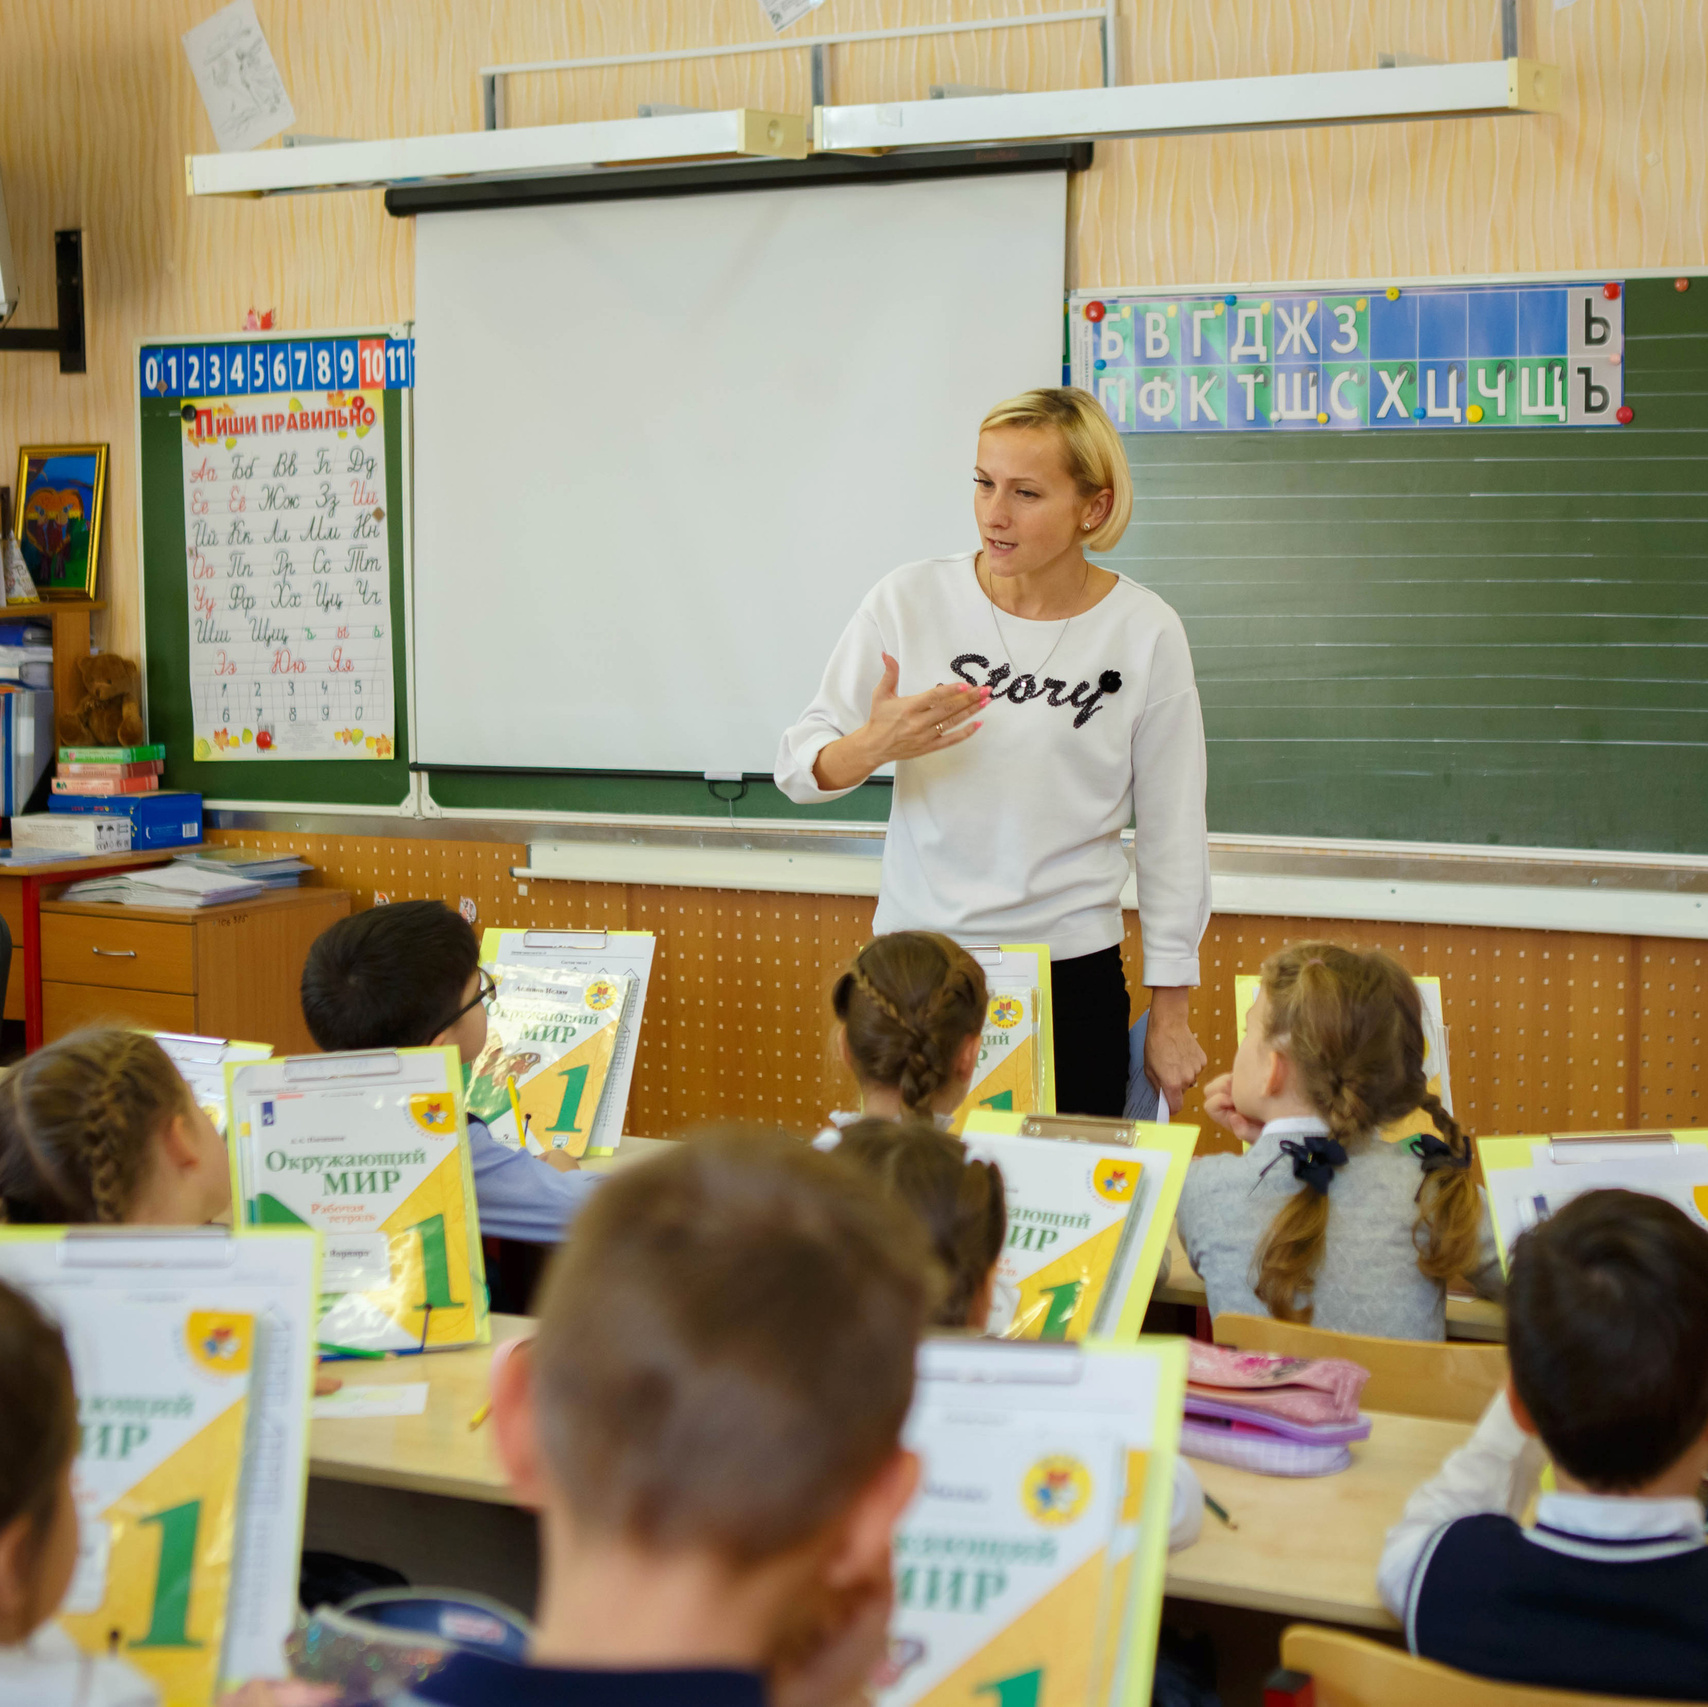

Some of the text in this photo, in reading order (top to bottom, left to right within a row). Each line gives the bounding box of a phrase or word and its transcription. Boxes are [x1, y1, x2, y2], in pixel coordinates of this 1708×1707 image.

[1101, 313, 1124, 360] Б
[1145, 312, 1170, 359] В
[1193, 310, 1217, 357] Г
[1230, 308, 1268, 363] Д
[1276, 306, 1318, 355] Ж
[1330, 305, 1359, 354] З
[1585, 298, 1611, 347] Ь
[145, 356, 158, 390] 0
[167, 355, 177, 389] 1
[188, 355, 200, 389] 2
[209, 354, 221, 388] 3
[230, 353, 245, 387] 4
[254, 352, 265, 387] 5
[273, 351, 287, 386] 6
[294, 351, 307, 385] 7
[317, 349, 332, 384] 8
[340, 349, 354, 383] 9
[362, 348, 384, 383] 10
[387, 347, 406, 381] 11
[1138, 376, 1176, 422] Ф
[1190, 375, 1219, 421] К
[1237, 373, 1265, 421] Т
[1277, 372, 1317, 420] Ш
[1330, 371, 1358, 420] С
[1376, 370, 1409, 419] Х
[1427, 369, 1462, 423] Ц
[1477, 368, 1506, 417] Ч
[1521, 366, 1566, 422] Щ
[1577, 366, 1611, 414] Ъ
[189, 457, 218, 483] Аа
[231, 453, 260, 480] Бб
[273, 452, 298, 477] Вв
[347, 447, 377, 480] Дд
[191, 488, 209, 515] Ее
[258, 486, 300, 511] Жж
[315, 484, 340, 518] Зз
[350, 480, 378, 507] Ии
[192, 512, 381, 547] Йй Кк Лл Мм Нн
[192, 545, 382, 584] Оо Пп Рр Сс Тт
[194, 580, 382, 619] Уу Фф Хх Цц Чч
[195, 618, 231, 644] Шш
[250, 618, 289, 648] Щщ
[337, 626, 350, 640] ы
[214, 647, 355, 676] Ээ Юю Яя
[221, 680, 362, 698] 1 2 3 4 5
[939, 653, 1104, 729] Story
[222, 706, 363, 723] 6 7 8 9 0
[519, 1023, 577, 1044] МИР
[545, 1064, 590, 1132] 1
[265, 1148, 426, 1173] Окружающий
[322, 1170, 400, 1196] МИР
[311, 1203, 365, 1215] Рабочая
[405, 1213, 464, 1311] 1
[128, 1499, 204, 1649] 1
